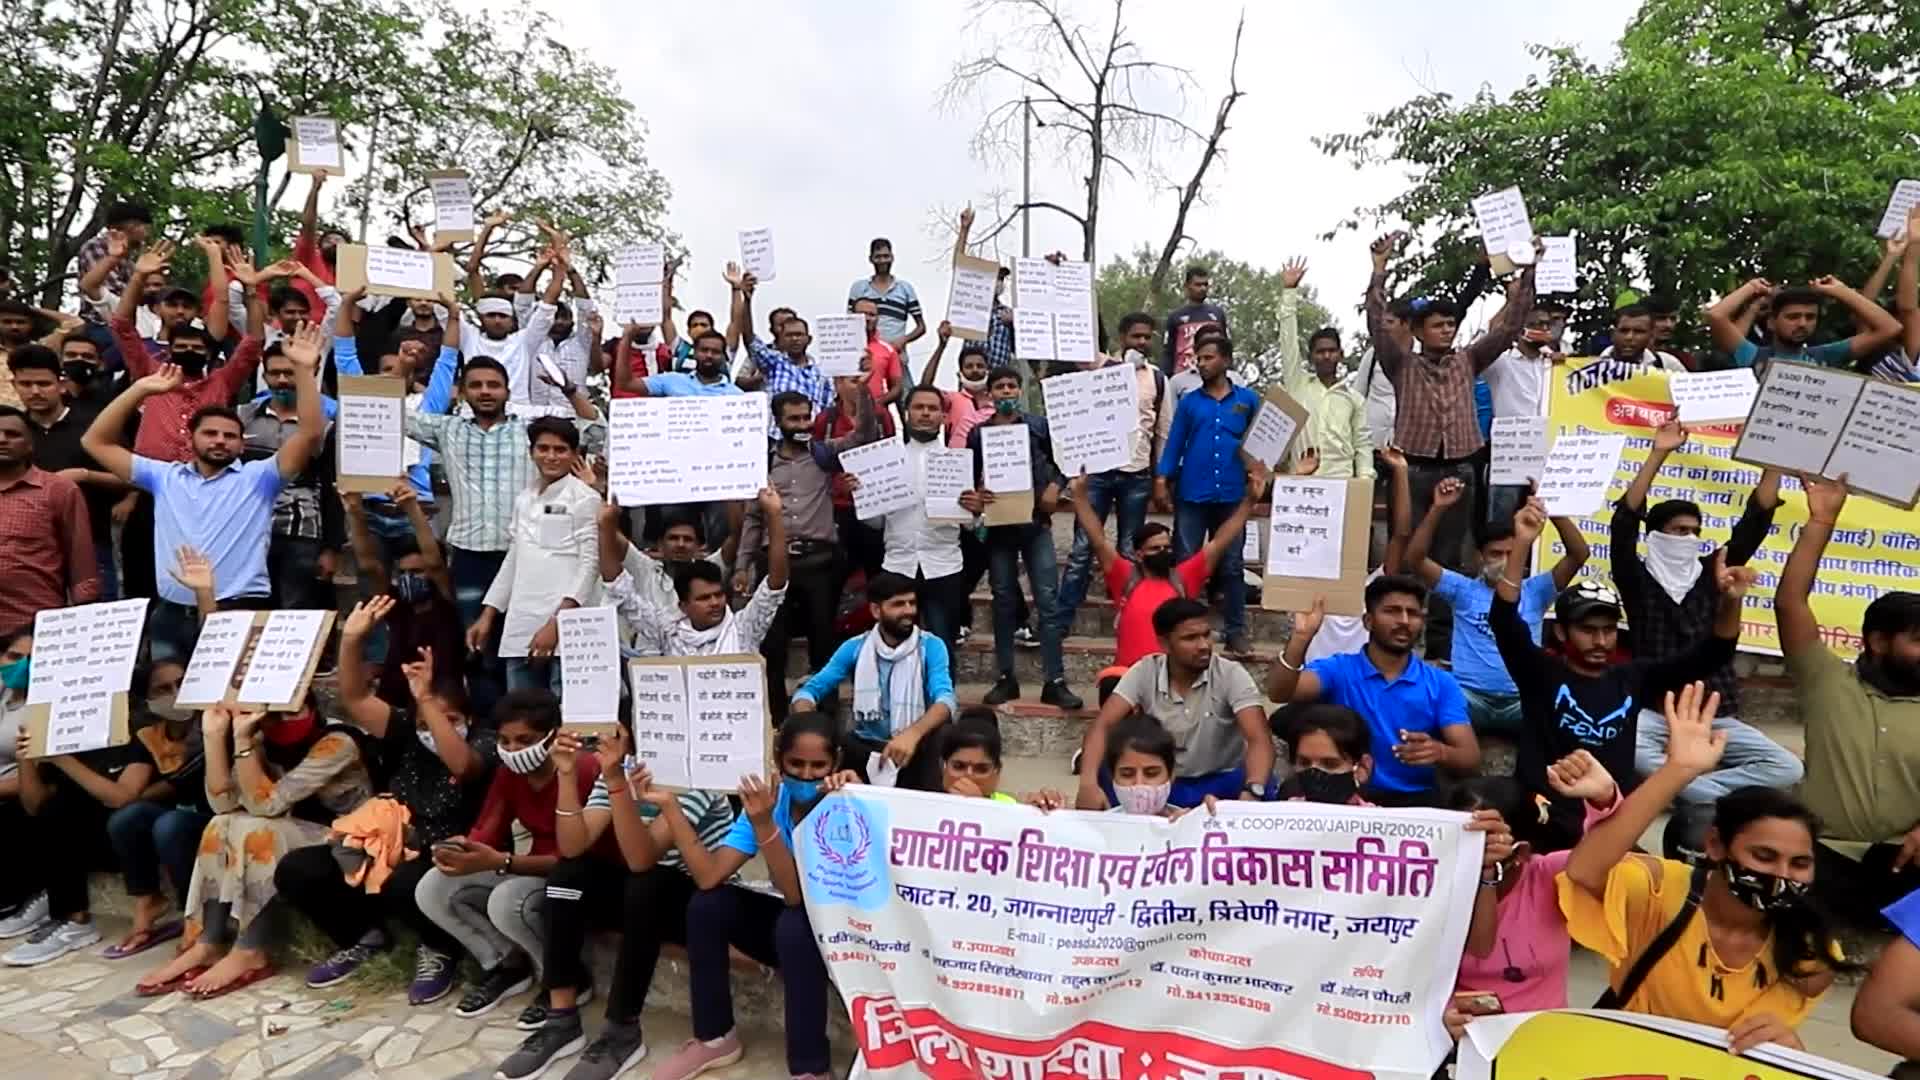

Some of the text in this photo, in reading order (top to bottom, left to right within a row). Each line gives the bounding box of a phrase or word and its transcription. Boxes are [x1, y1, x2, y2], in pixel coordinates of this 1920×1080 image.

[1566, 360, 1648, 396] राजस्था
[1242, 817, 1445, 842] COOP/2020/JAIPUR/200241
[890, 818, 1012, 876] शारीरिक
[1016, 827, 1095, 890] शिक्षा
[1141, 840, 1196, 889] खेल
[1202, 831, 1314, 889] विकास
[1320, 837, 1439, 898] समिति
[966, 893, 997, 916] 20,
[1003, 898, 1116, 933] जगन्नाथपुरी
[1131, 899, 1204, 928] द्वितीय,
[1208, 899, 1278, 926] त्रिवेणी
[1283, 907, 1338, 940] नगर,
[1346, 915, 1420, 944] जयपुर
[1007, 928, 1046, 945] E-mail
